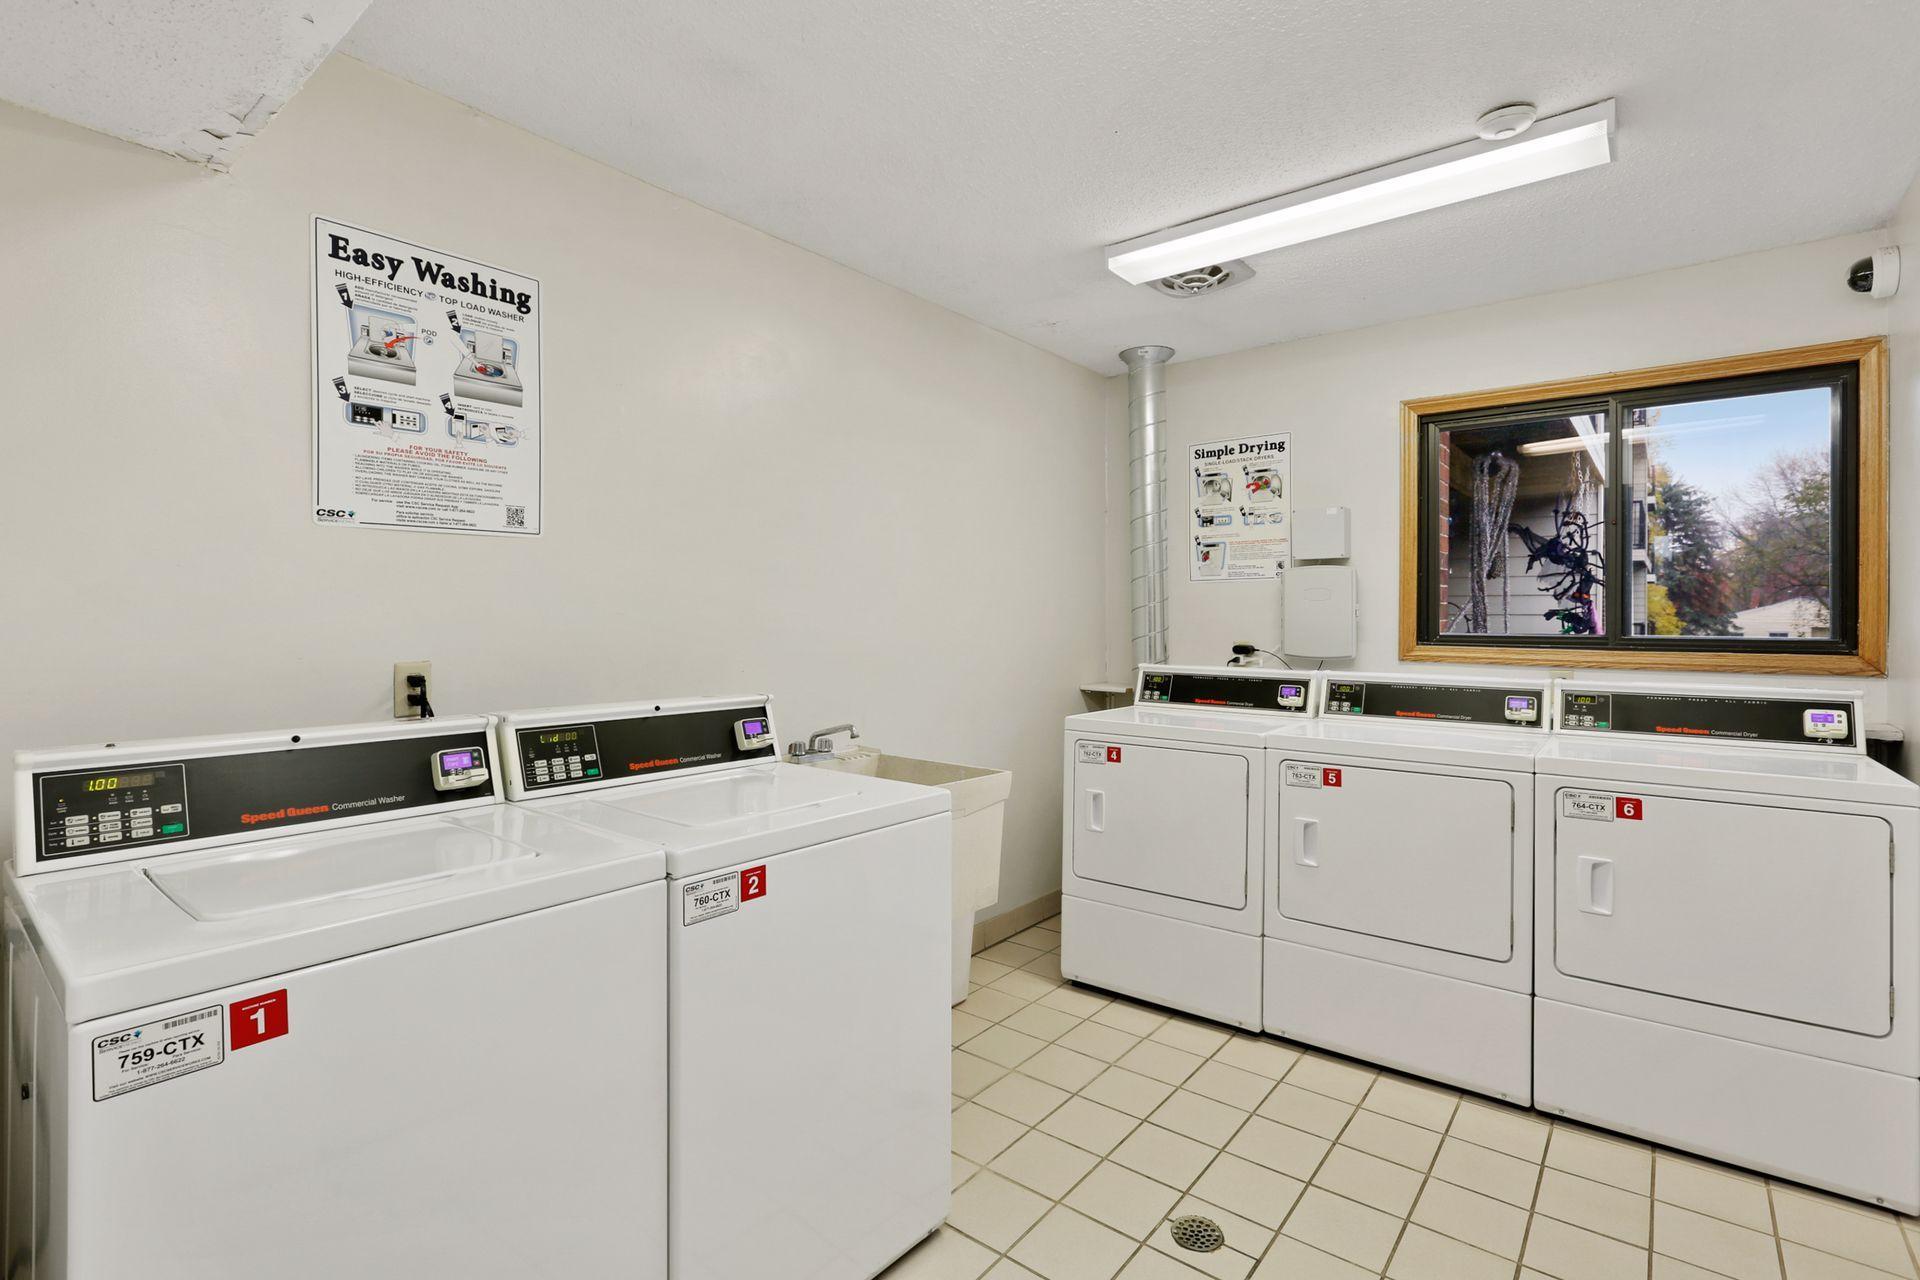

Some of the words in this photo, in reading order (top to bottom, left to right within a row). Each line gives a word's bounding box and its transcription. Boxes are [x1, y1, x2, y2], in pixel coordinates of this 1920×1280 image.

[328, 233, 404, 281] Easy
[411, 256, 532, 315] Washing
[334, 269, 424, 298] HIGH-EFFICIENCY
[439, 295, 458, 305] TOP
[460, 301, 486, 314] LOAD
[487, 307, 525, 323] WASHER
[341, 292, 348, 301] 1
[451, 318, 458, 326] 2
[338, 385, 346, 394] 3
[387, 447, 413, 455] PLEASE
[452, 455, 487, 464] FOLLOWING
[1194, 445, 1235, 460] Simple
[1239, 441, 1286, 455] Drying
[316, 508, 346, 518] CSC
[1656, 726, 1682, 734] Speed
[1711, 729, 1743, 737] Commercial
[1743, 731, 1758, 739] Dryer
[629, 760, 654, 771] Speed
[655, 758, 679, 767] Queen
[679, 755, 706, 764] Commercial
[706, 752, 722, 760] Washer
[1111, 751, 1117, 760] 4
[1328, 773, 1336, 784] 5
[241, 809, 286, 825] Speed
[287, 804, 329, 818] Queen
[332, 798, 377, 811] Commercial
[378, 793, 405, 805] Washer
[1572, 802, 1606, 811] 764-CTX
[1623, 803, 1635, 816] 6
[685, 884, 701, 893] CSC
[748, 875, 759, 895] 2
[694, 889, 731, 907] 760-CTX
[250, 1007, 266, 1035] 1
[97, 1033, 132, 1048] CSC
[118, 1033, 205, 1070] 759-CTX
